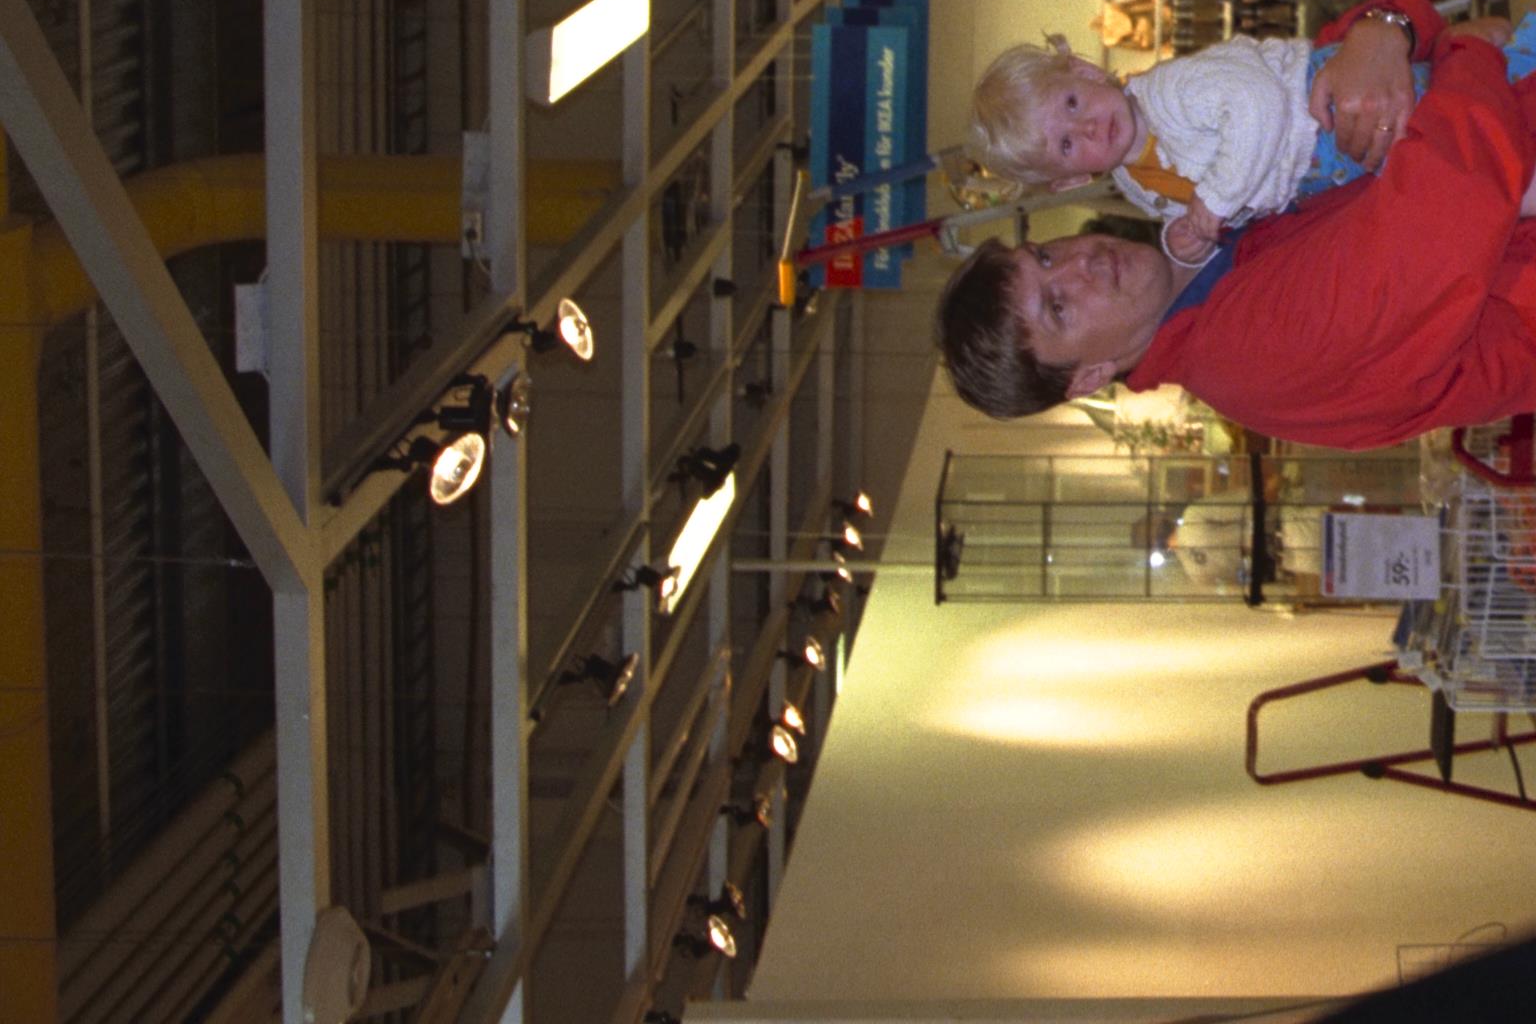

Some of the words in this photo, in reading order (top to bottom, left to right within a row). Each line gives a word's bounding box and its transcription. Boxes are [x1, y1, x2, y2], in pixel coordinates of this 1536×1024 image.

[876, 46, 896, 96] kunder
[876, 99, 893, 133] IKEA
[874, 135, 893, 157] för
